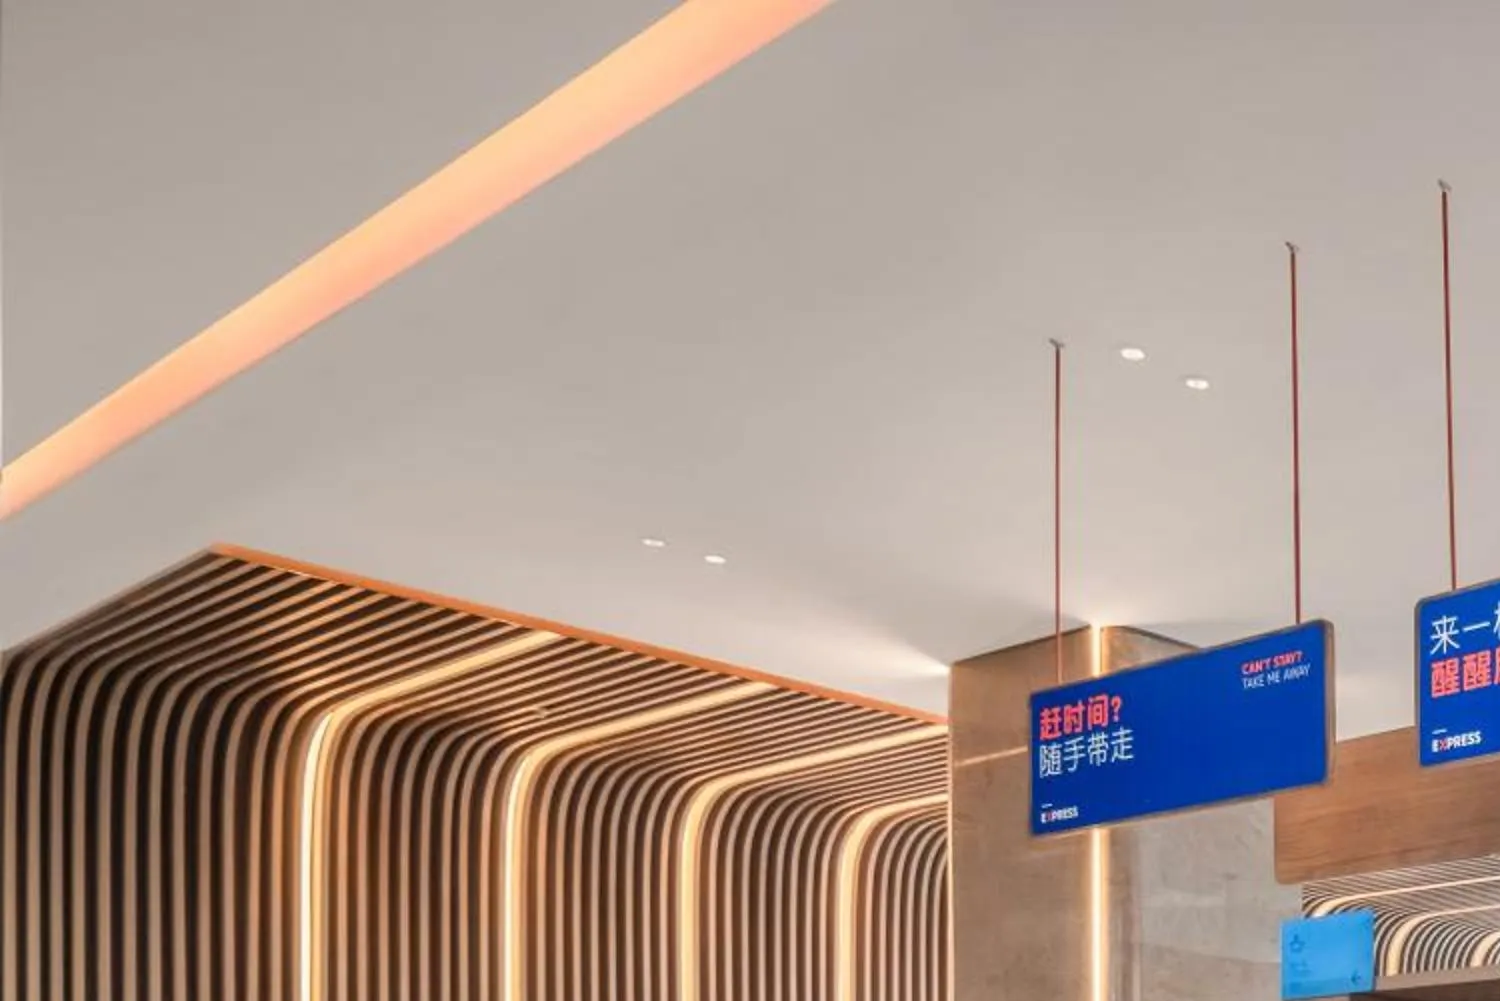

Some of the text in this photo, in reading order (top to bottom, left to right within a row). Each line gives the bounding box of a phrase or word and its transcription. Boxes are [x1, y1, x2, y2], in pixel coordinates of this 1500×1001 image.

[1242, 662, 1311, 689] TAKE ME AWAY
[1039, 727, 1134, 778] 随手带走
[1431, 730, 1481, 753] EXPRESS
[1041, 805, 1079, 824] EXPRESS
